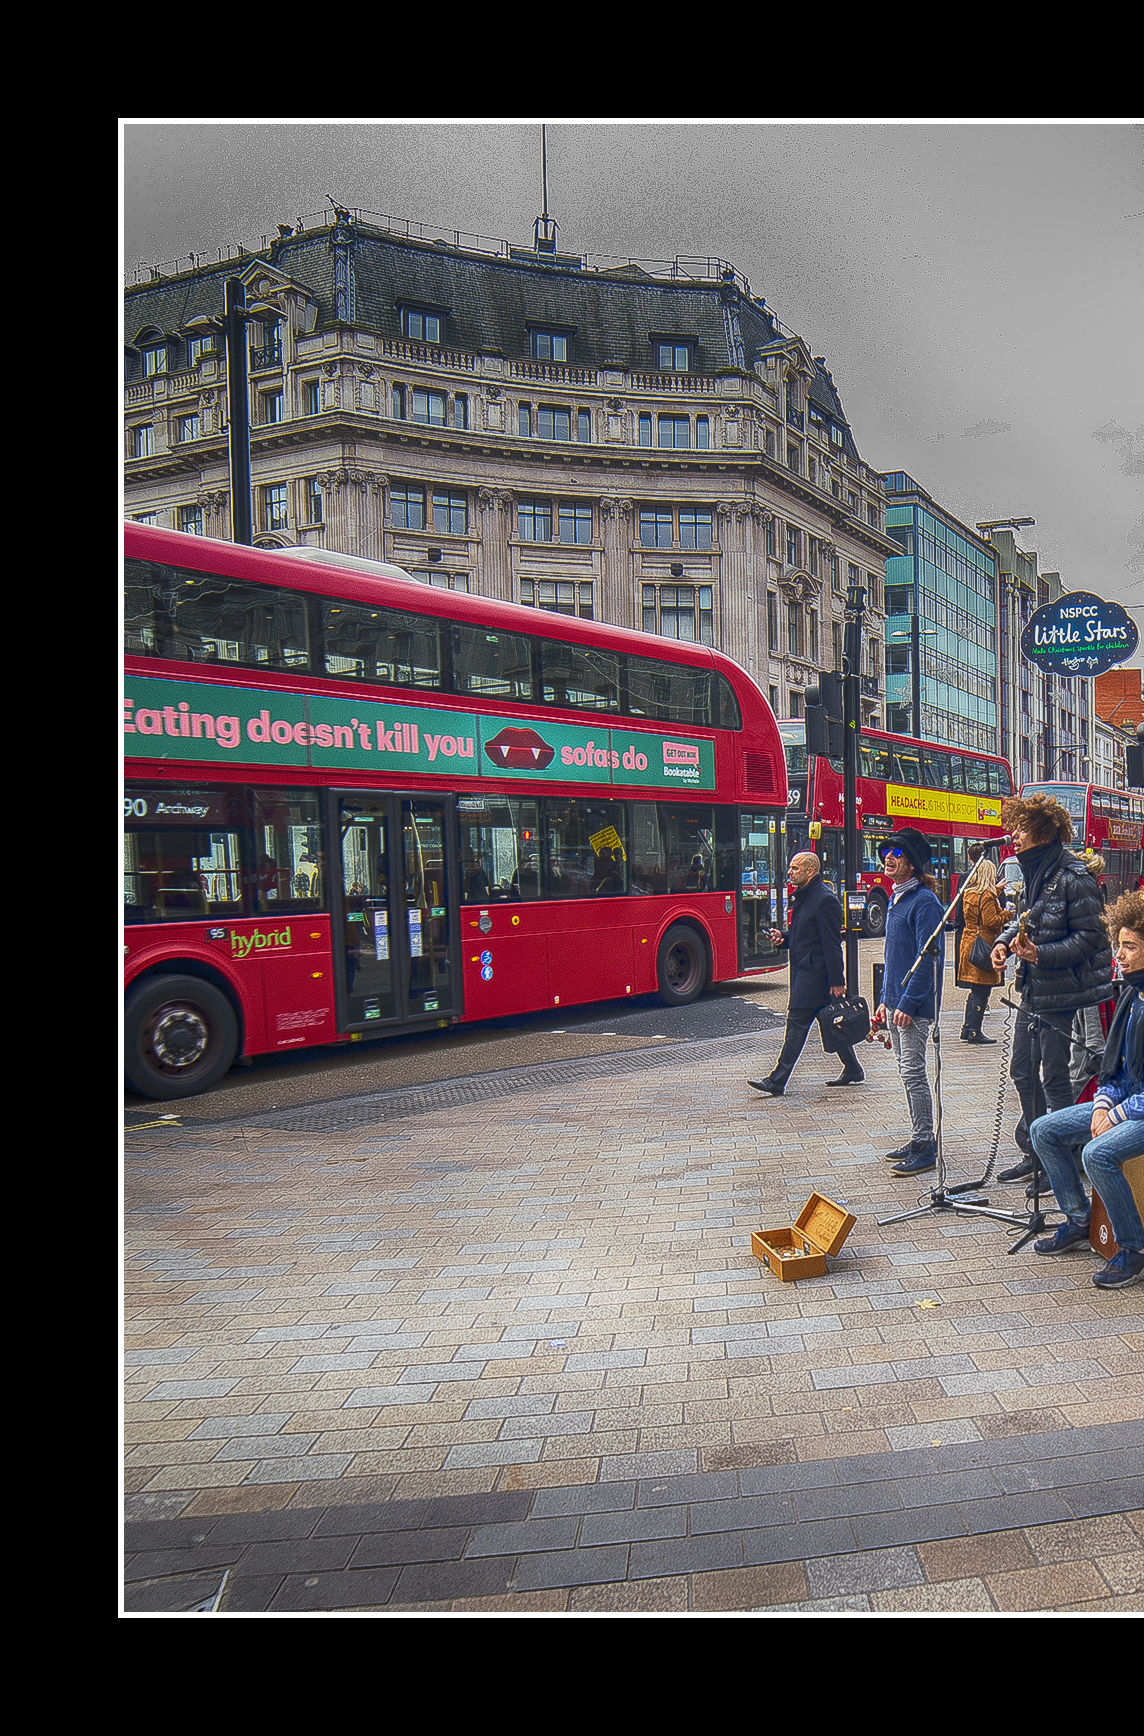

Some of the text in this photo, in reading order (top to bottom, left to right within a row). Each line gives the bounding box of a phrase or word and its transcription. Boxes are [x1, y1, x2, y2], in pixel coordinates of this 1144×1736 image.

[1060, 605, 1098, 619] NSPCC
[1084, 620, 1127, 642] Stars
[247, 710, 372, 750] doesn't
[376, 720, 419, 754] kill
[423, 733, 475, 761] you
[560, 741, 620, 769] sofas
[623, 746, 648, 771] do
[928, 799, 934, 811] IS
[934, 800, 945, 813] THIS
[946, 802, 962, 815] YOUR
[231, 925, 292, 958] hybrid
